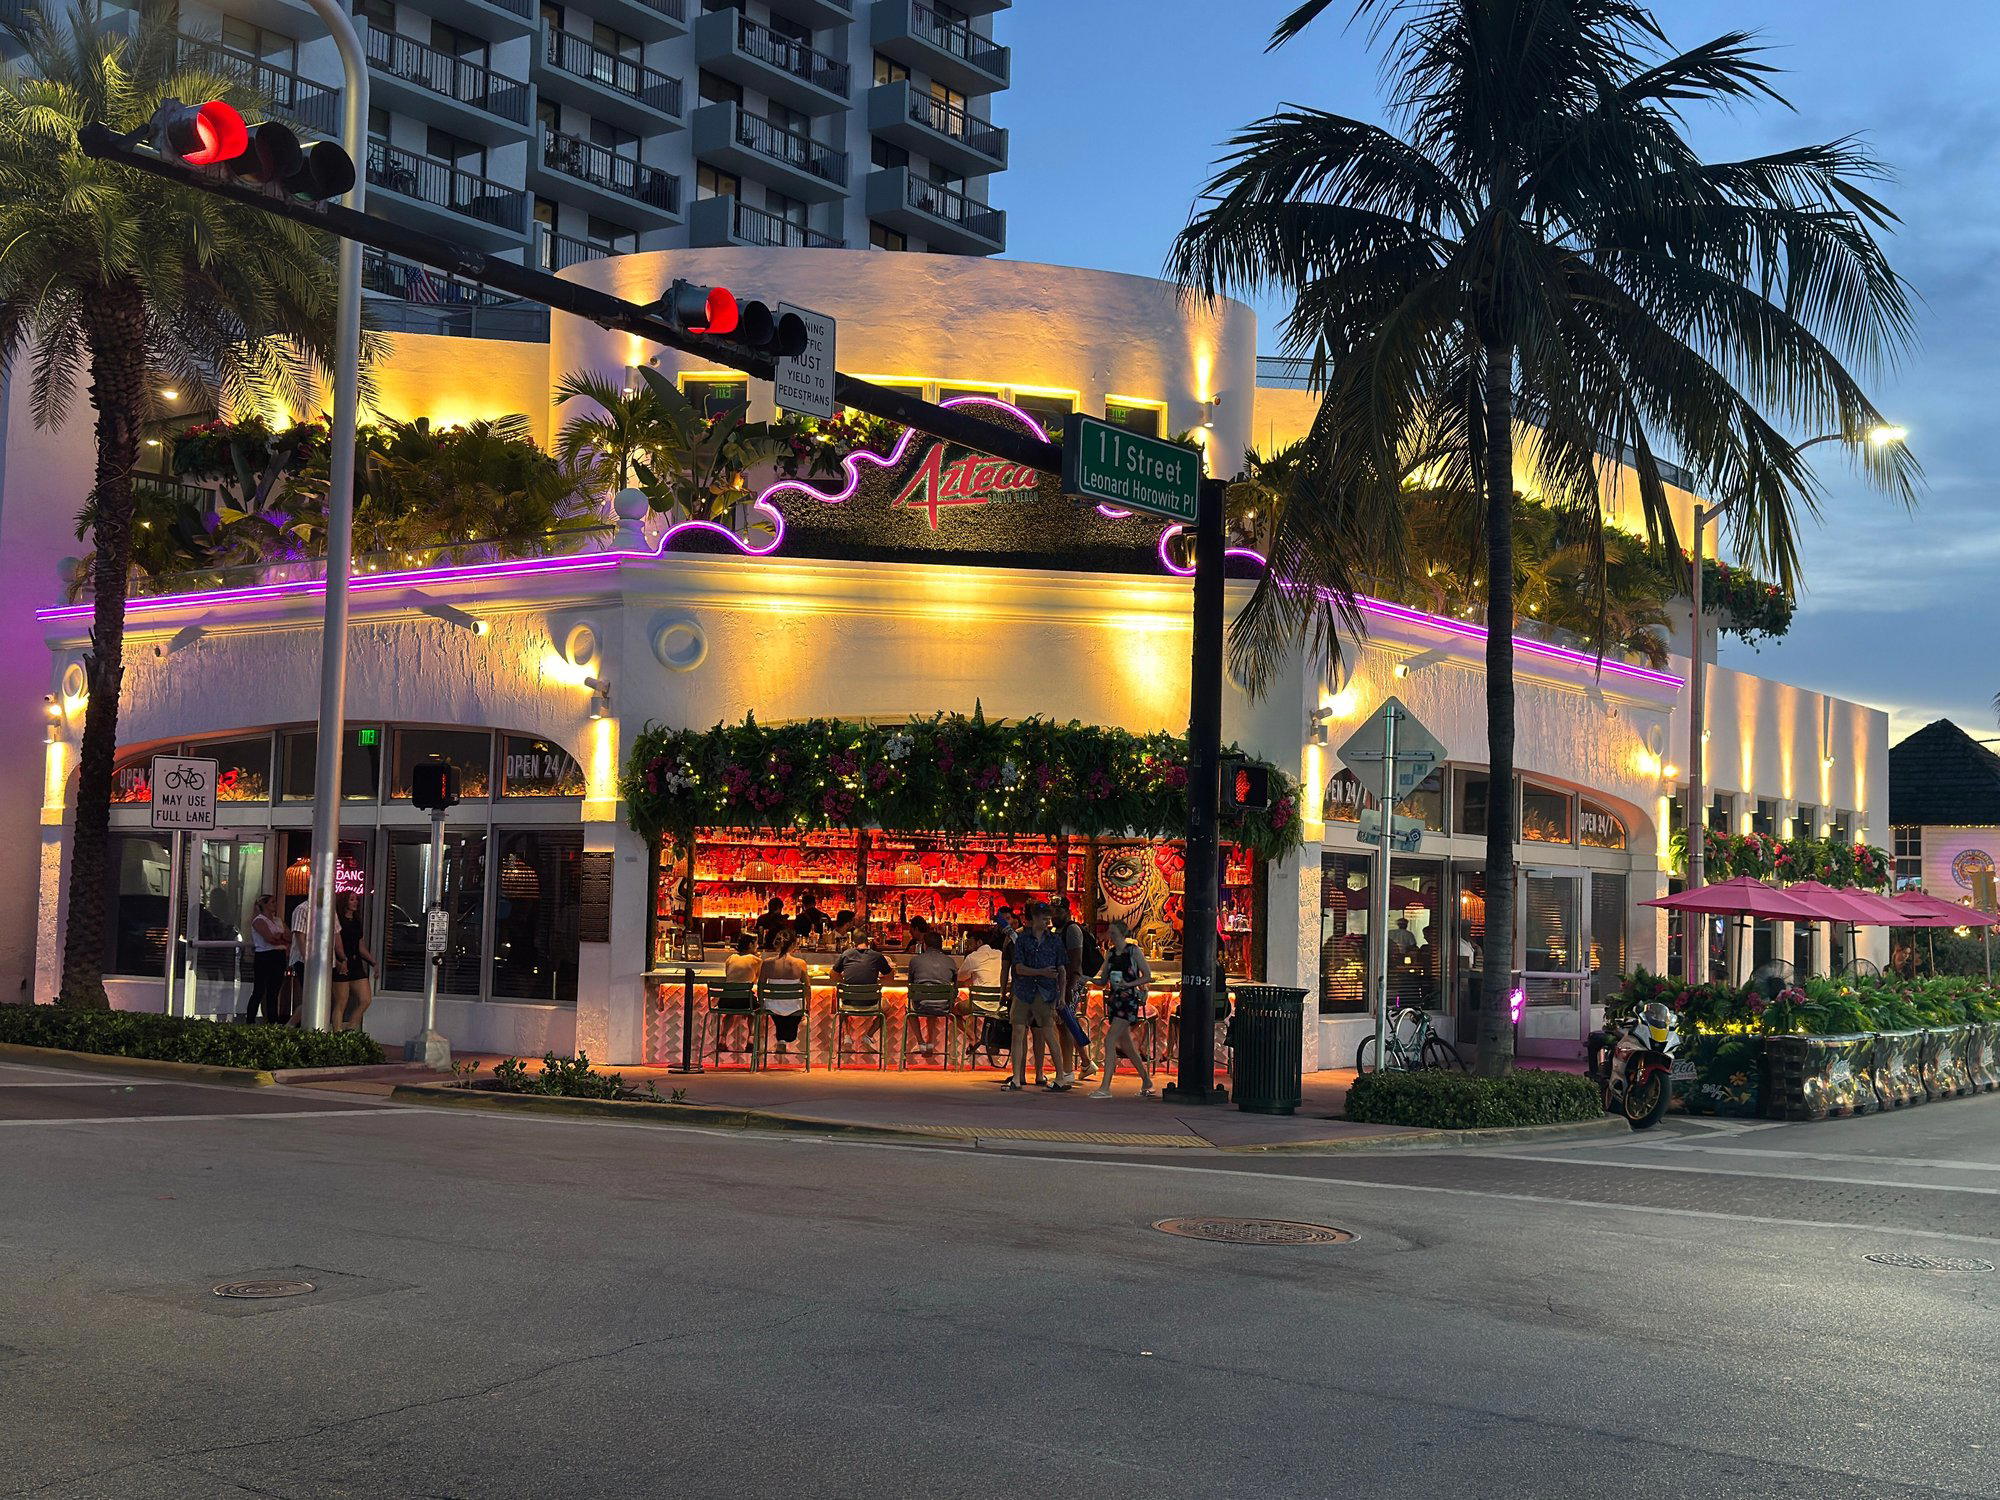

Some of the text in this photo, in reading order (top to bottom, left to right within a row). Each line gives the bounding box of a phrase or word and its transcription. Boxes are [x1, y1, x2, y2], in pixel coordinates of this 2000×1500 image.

[804, 320, 825, 336] NING
[790, 354, 821, 371] MUST
[787, 370, 825, 389] YIELD TO
[779, 384, 830, 407] PEDESTRIANS
[1099, 430, 1181, 485] 11 Street
[892, 442, 1039, 531] Azteca
[1083, 465, 1194, 514] Leonard Horowitz Pl
[506, 753, 540, 780] OPEN
[162, 794, 206, 807] MAY USE
[1325, 779, 1344, 803] PEN
[156, 809, 211, 822] FULL LANE
[335, 869, 365, 881] DANC
